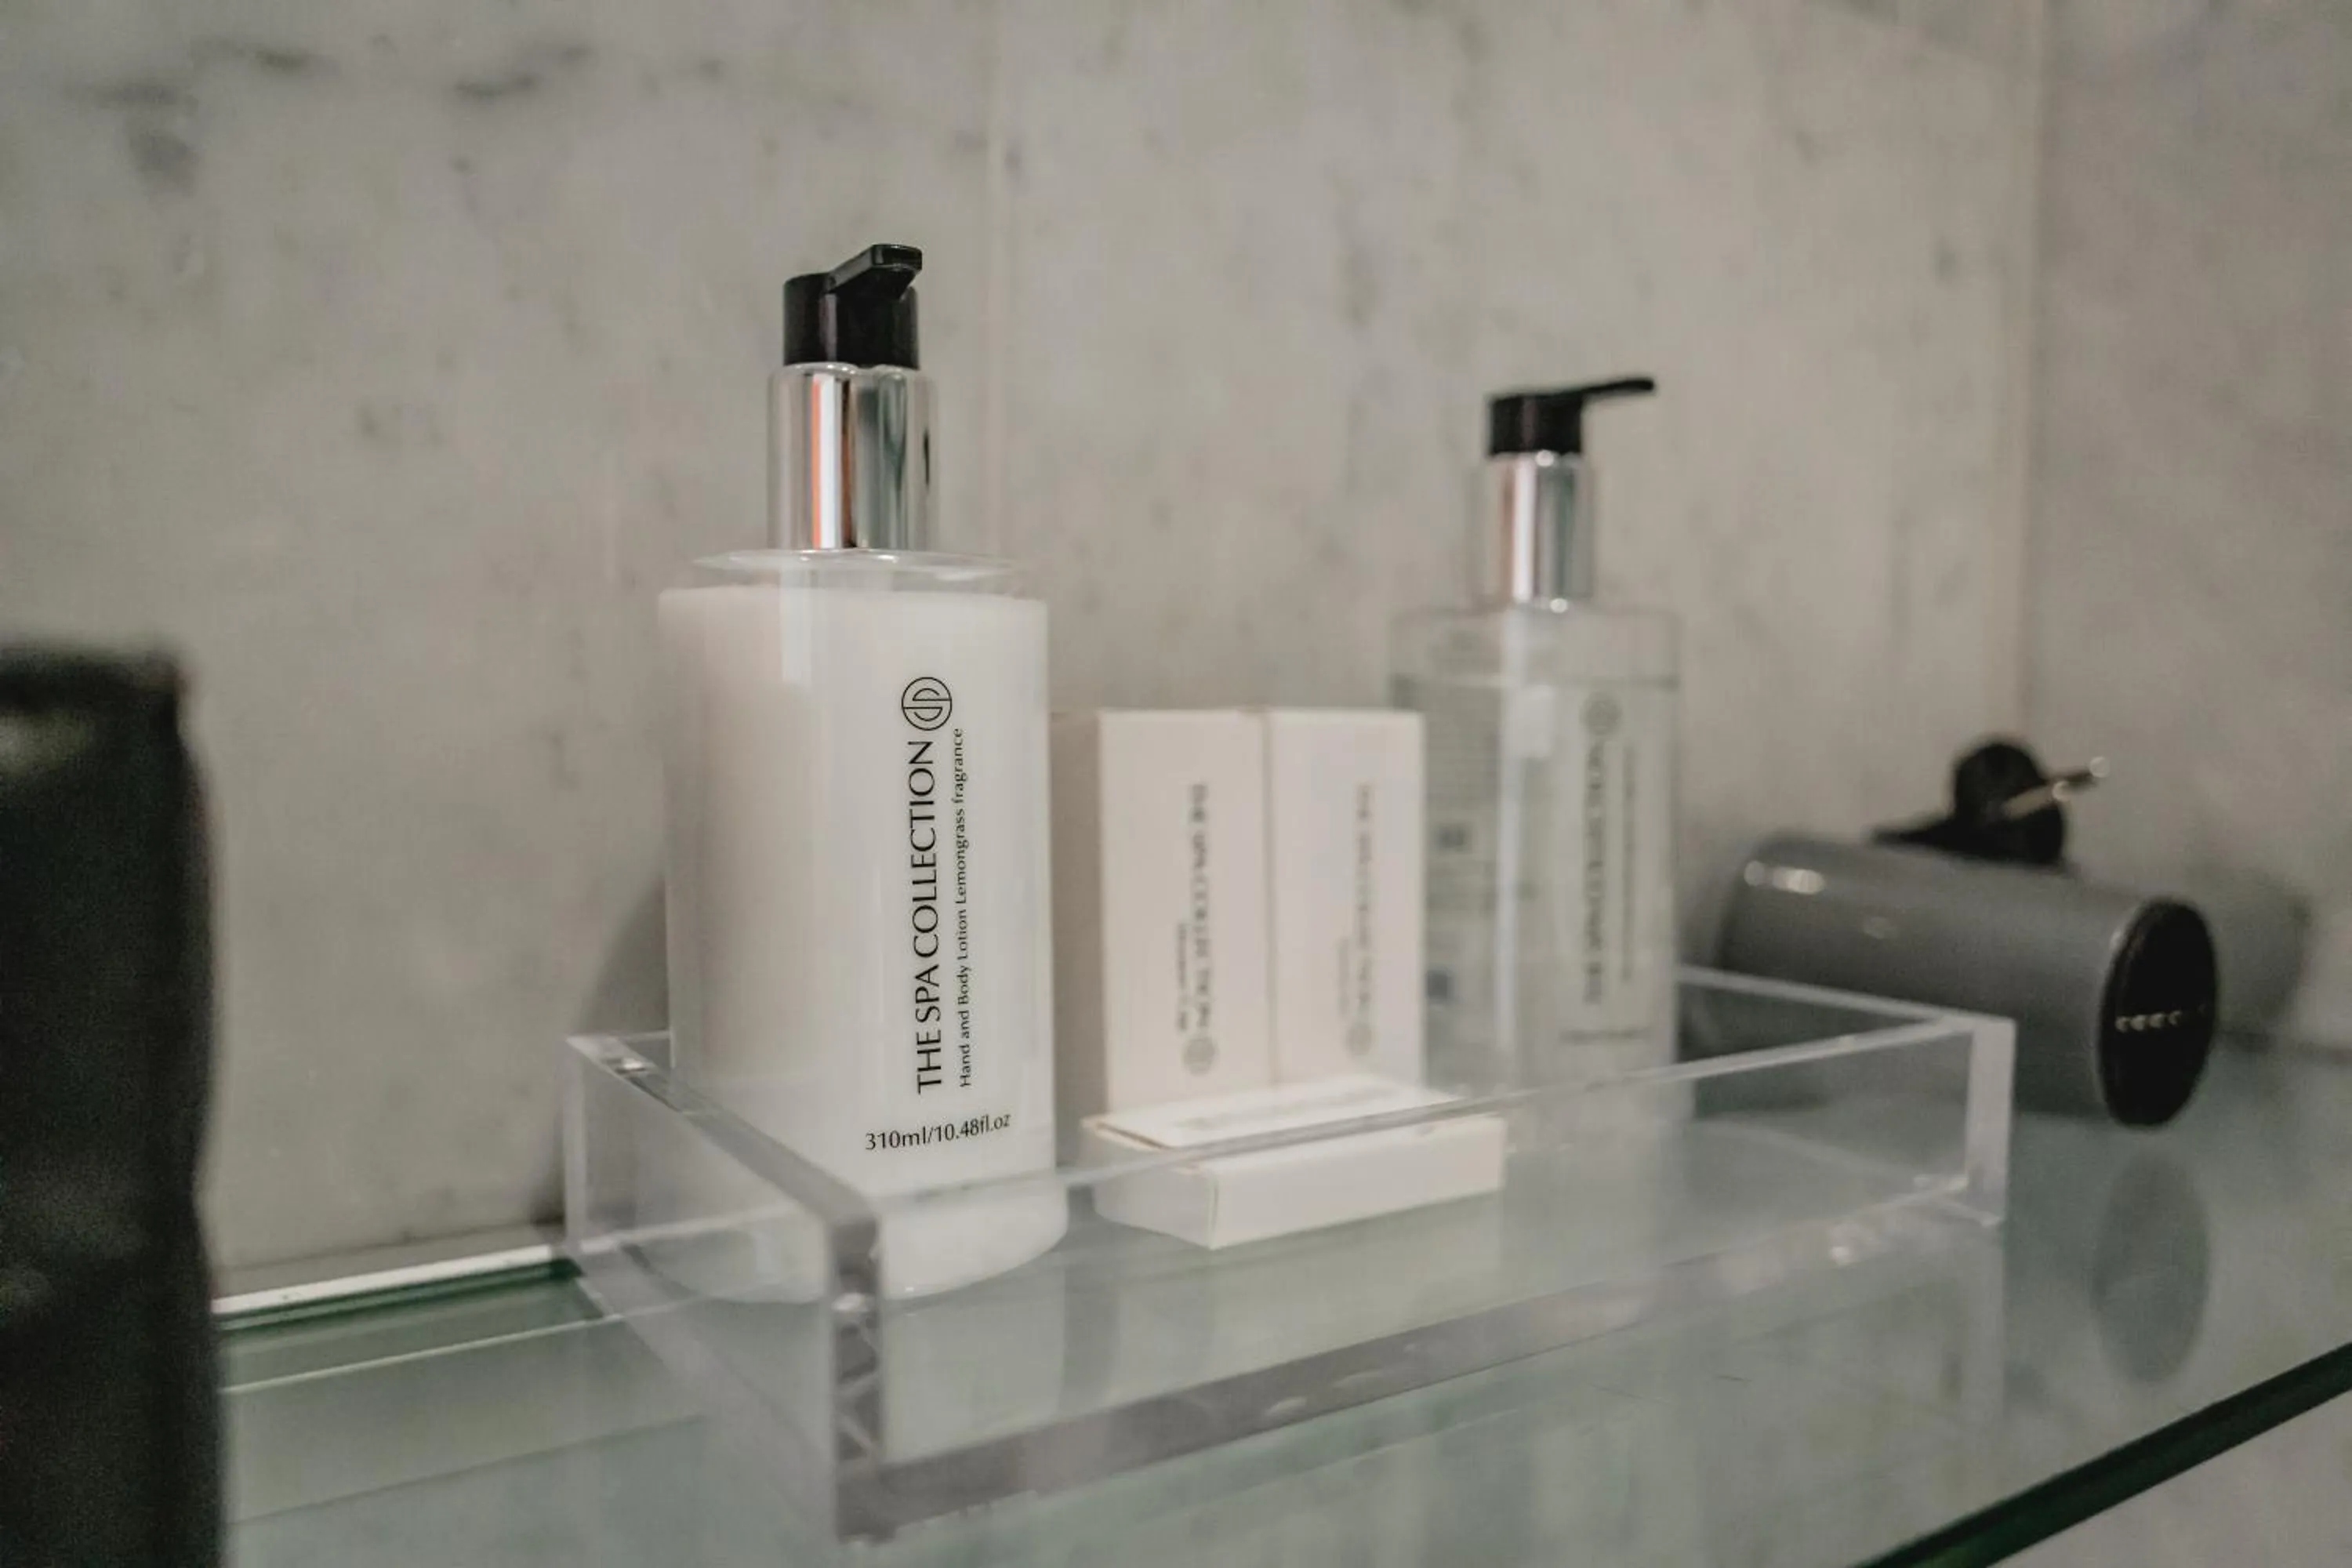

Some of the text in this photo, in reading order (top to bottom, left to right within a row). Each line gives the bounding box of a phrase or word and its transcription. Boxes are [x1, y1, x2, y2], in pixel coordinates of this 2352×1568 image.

[907, 741, 942, 1094] THE SPA COLLECTION
[951, 728, 971, 1087] Hand and Body Lotion Lemongrass fragrance
